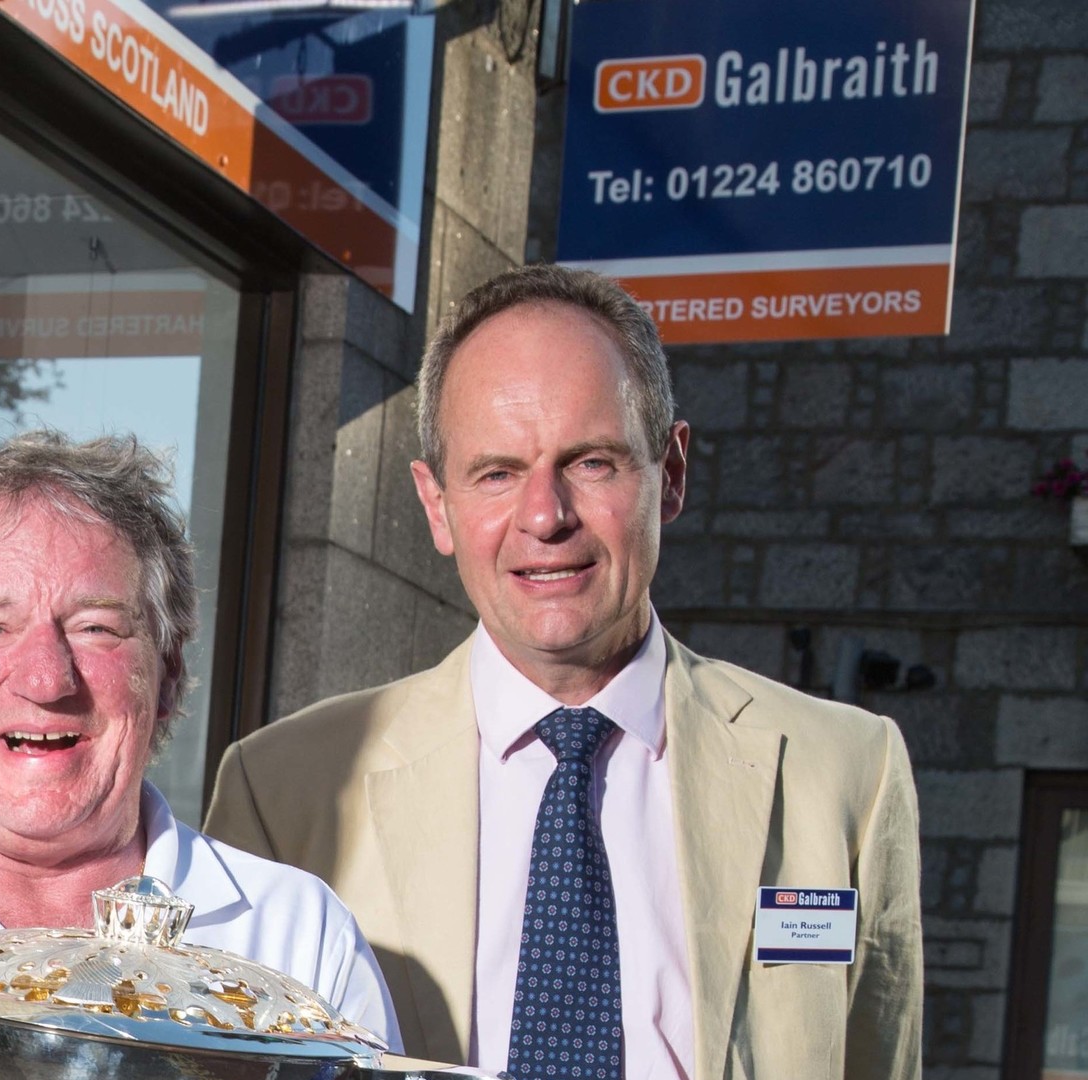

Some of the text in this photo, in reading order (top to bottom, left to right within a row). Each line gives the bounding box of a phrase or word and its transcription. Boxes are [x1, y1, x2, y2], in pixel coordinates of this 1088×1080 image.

[90, 10, 209, 137] SCOTLAND
[608, 38, 938, 107] CKD Galbraith
[587, 154, 933, 205] Tel: 01224 860710
[751, 290, 922, 319] SURVEYORS
[778, 892, 840, 906] CKD Galbraith
[781, 921, 832, 930] Iain Russell
[791, 931, 820, 939] Partner
